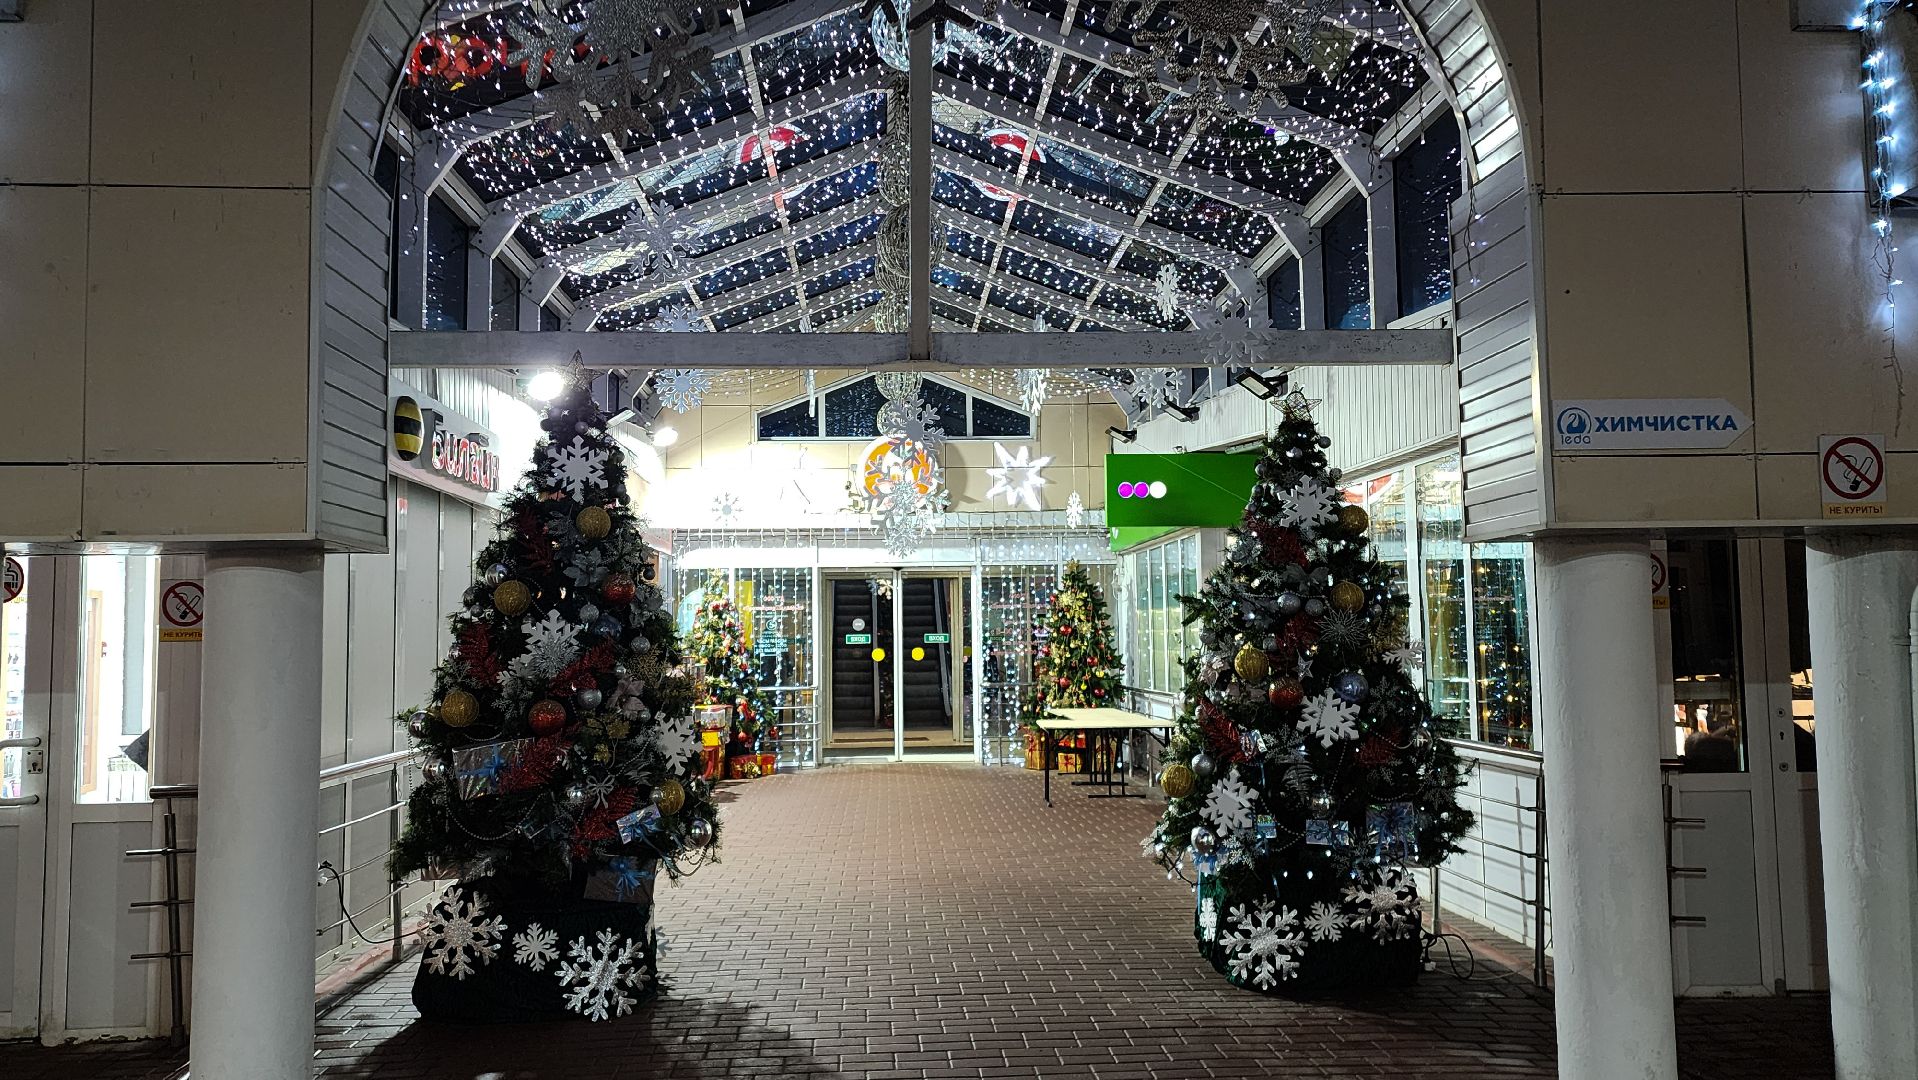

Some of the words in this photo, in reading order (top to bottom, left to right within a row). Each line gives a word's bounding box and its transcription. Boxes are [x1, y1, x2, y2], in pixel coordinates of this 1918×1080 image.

[1594, 415, 1738, 433] ХИМЧИСТКА
[1561, 434, 1591, 445] leda
[1829, 506, 1841, 515] НЕ
[1844, 505, 1883, 515] КУРИТЬ!
